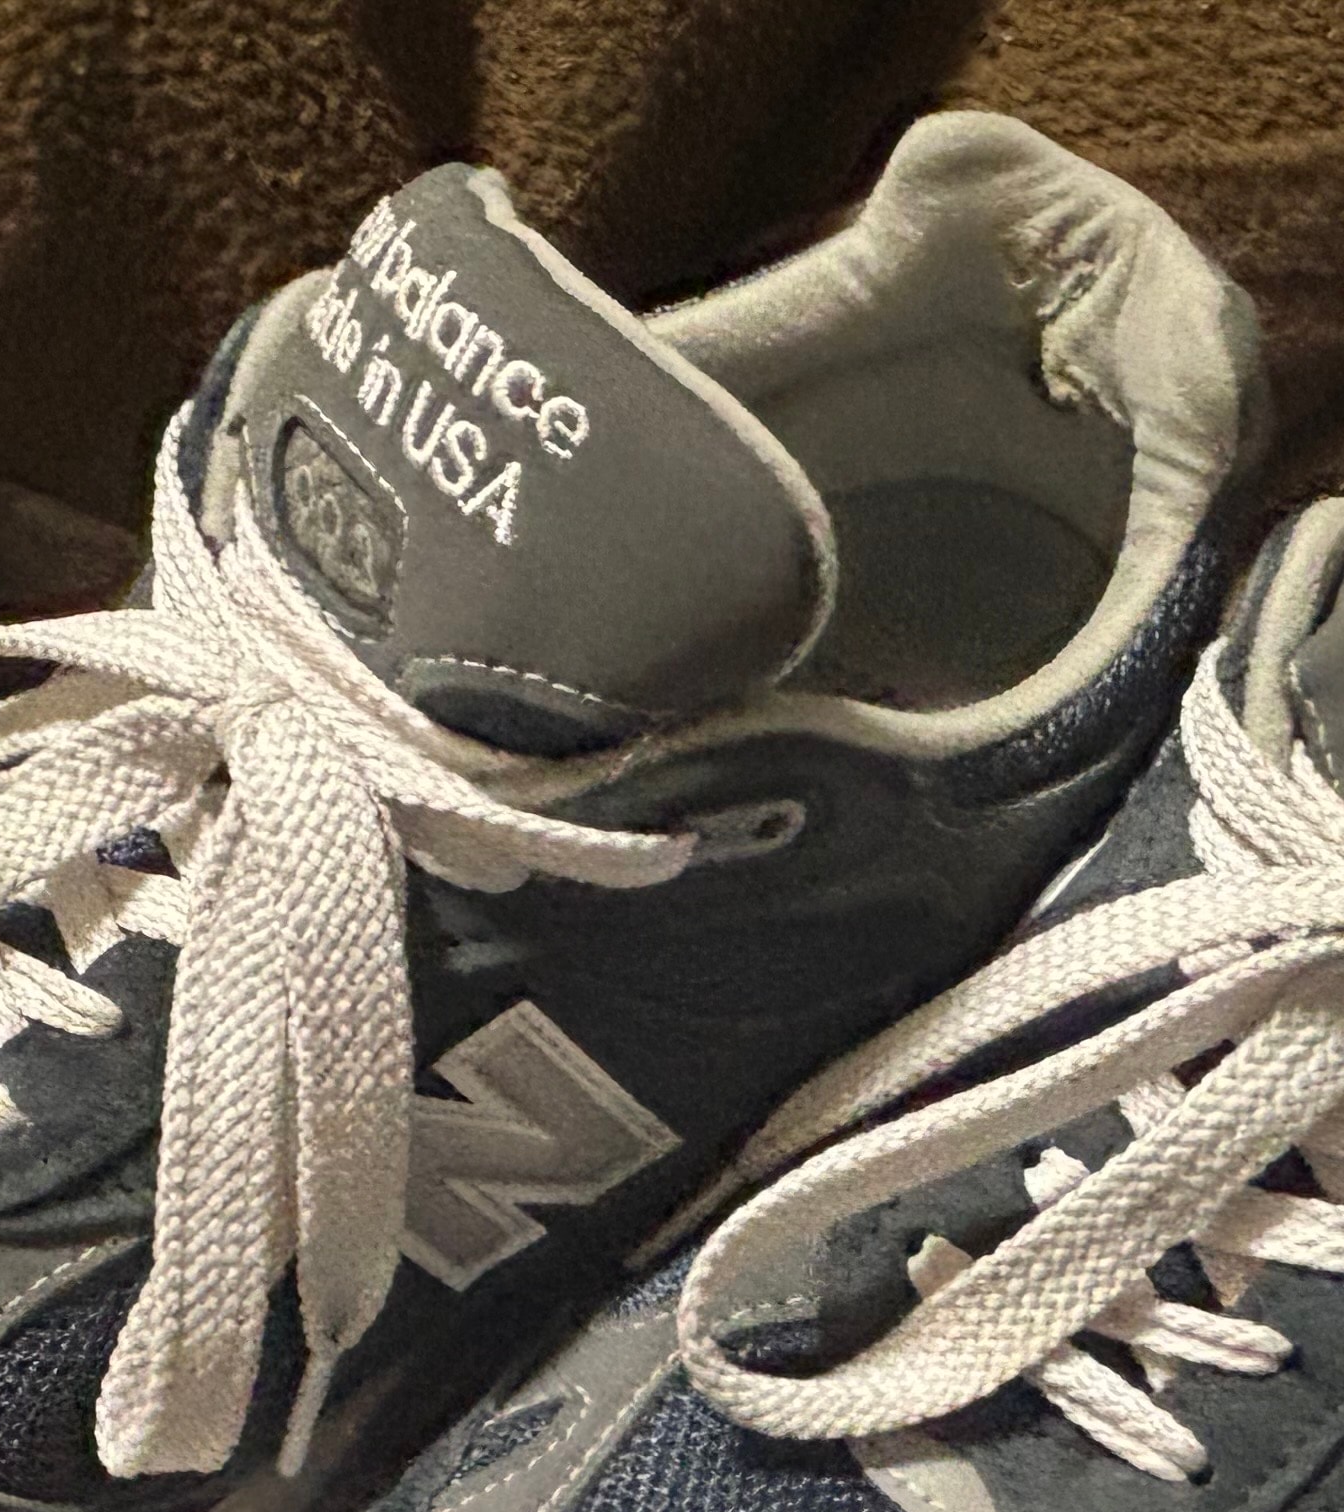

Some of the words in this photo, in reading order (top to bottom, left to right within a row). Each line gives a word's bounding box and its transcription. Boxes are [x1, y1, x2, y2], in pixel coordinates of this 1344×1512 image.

[357, 333, 403, 427] in
[401, 381, 524, 546] USA
[369, 219, 590, 460] balance
